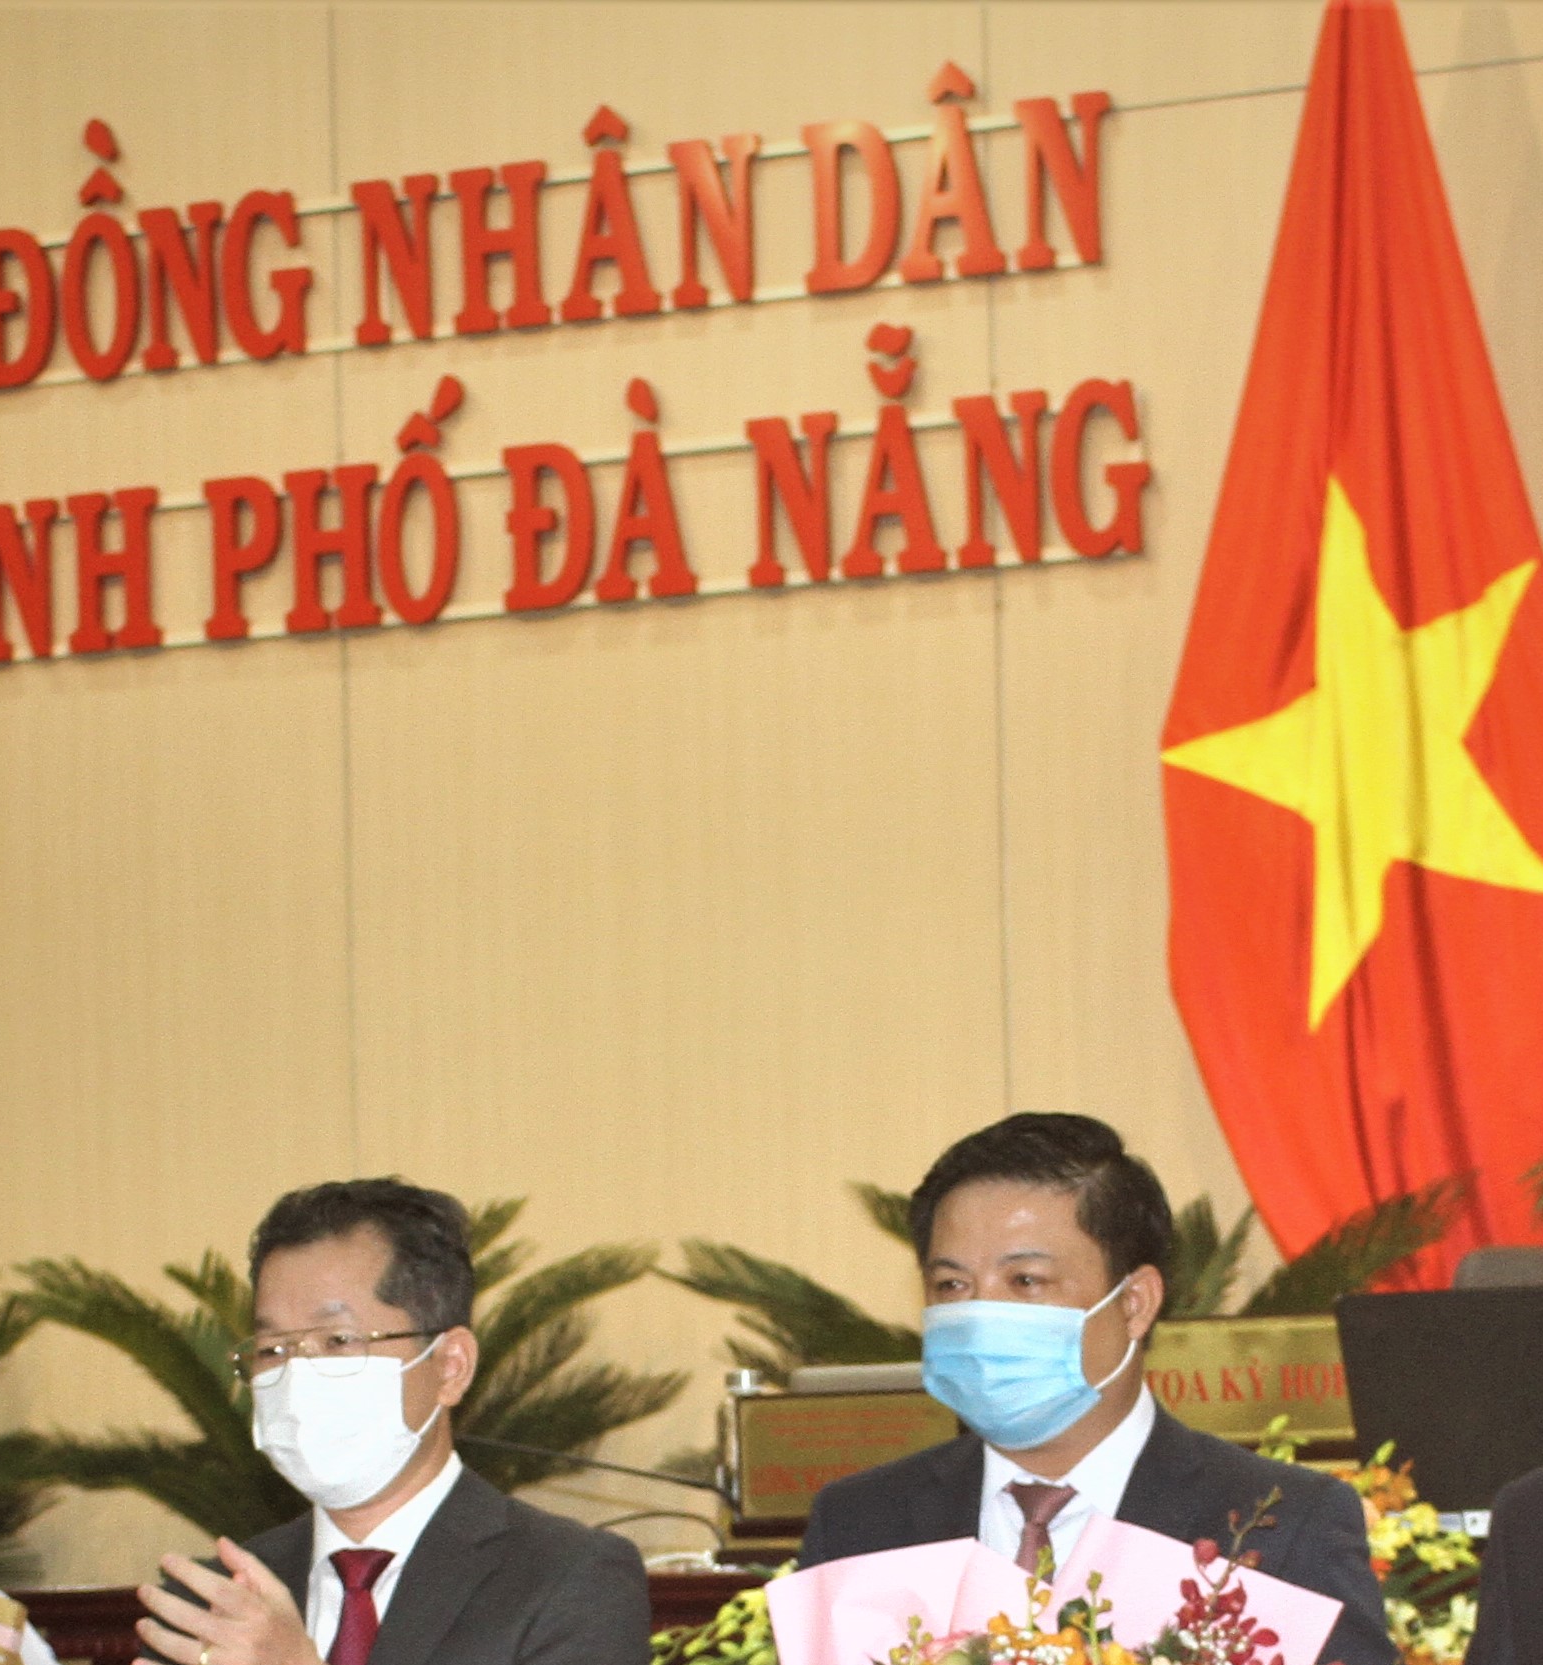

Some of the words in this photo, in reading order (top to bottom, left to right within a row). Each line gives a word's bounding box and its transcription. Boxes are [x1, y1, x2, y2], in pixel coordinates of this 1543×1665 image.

[350, 105, 761, 346] NHÂN
[802, 61, 1111, 298] DÂN
[201, 374, 466, 641] PHỐ
[502, 377, 699, 614] ĐÀ
[744, 322, 1152, 589] NẴNG
